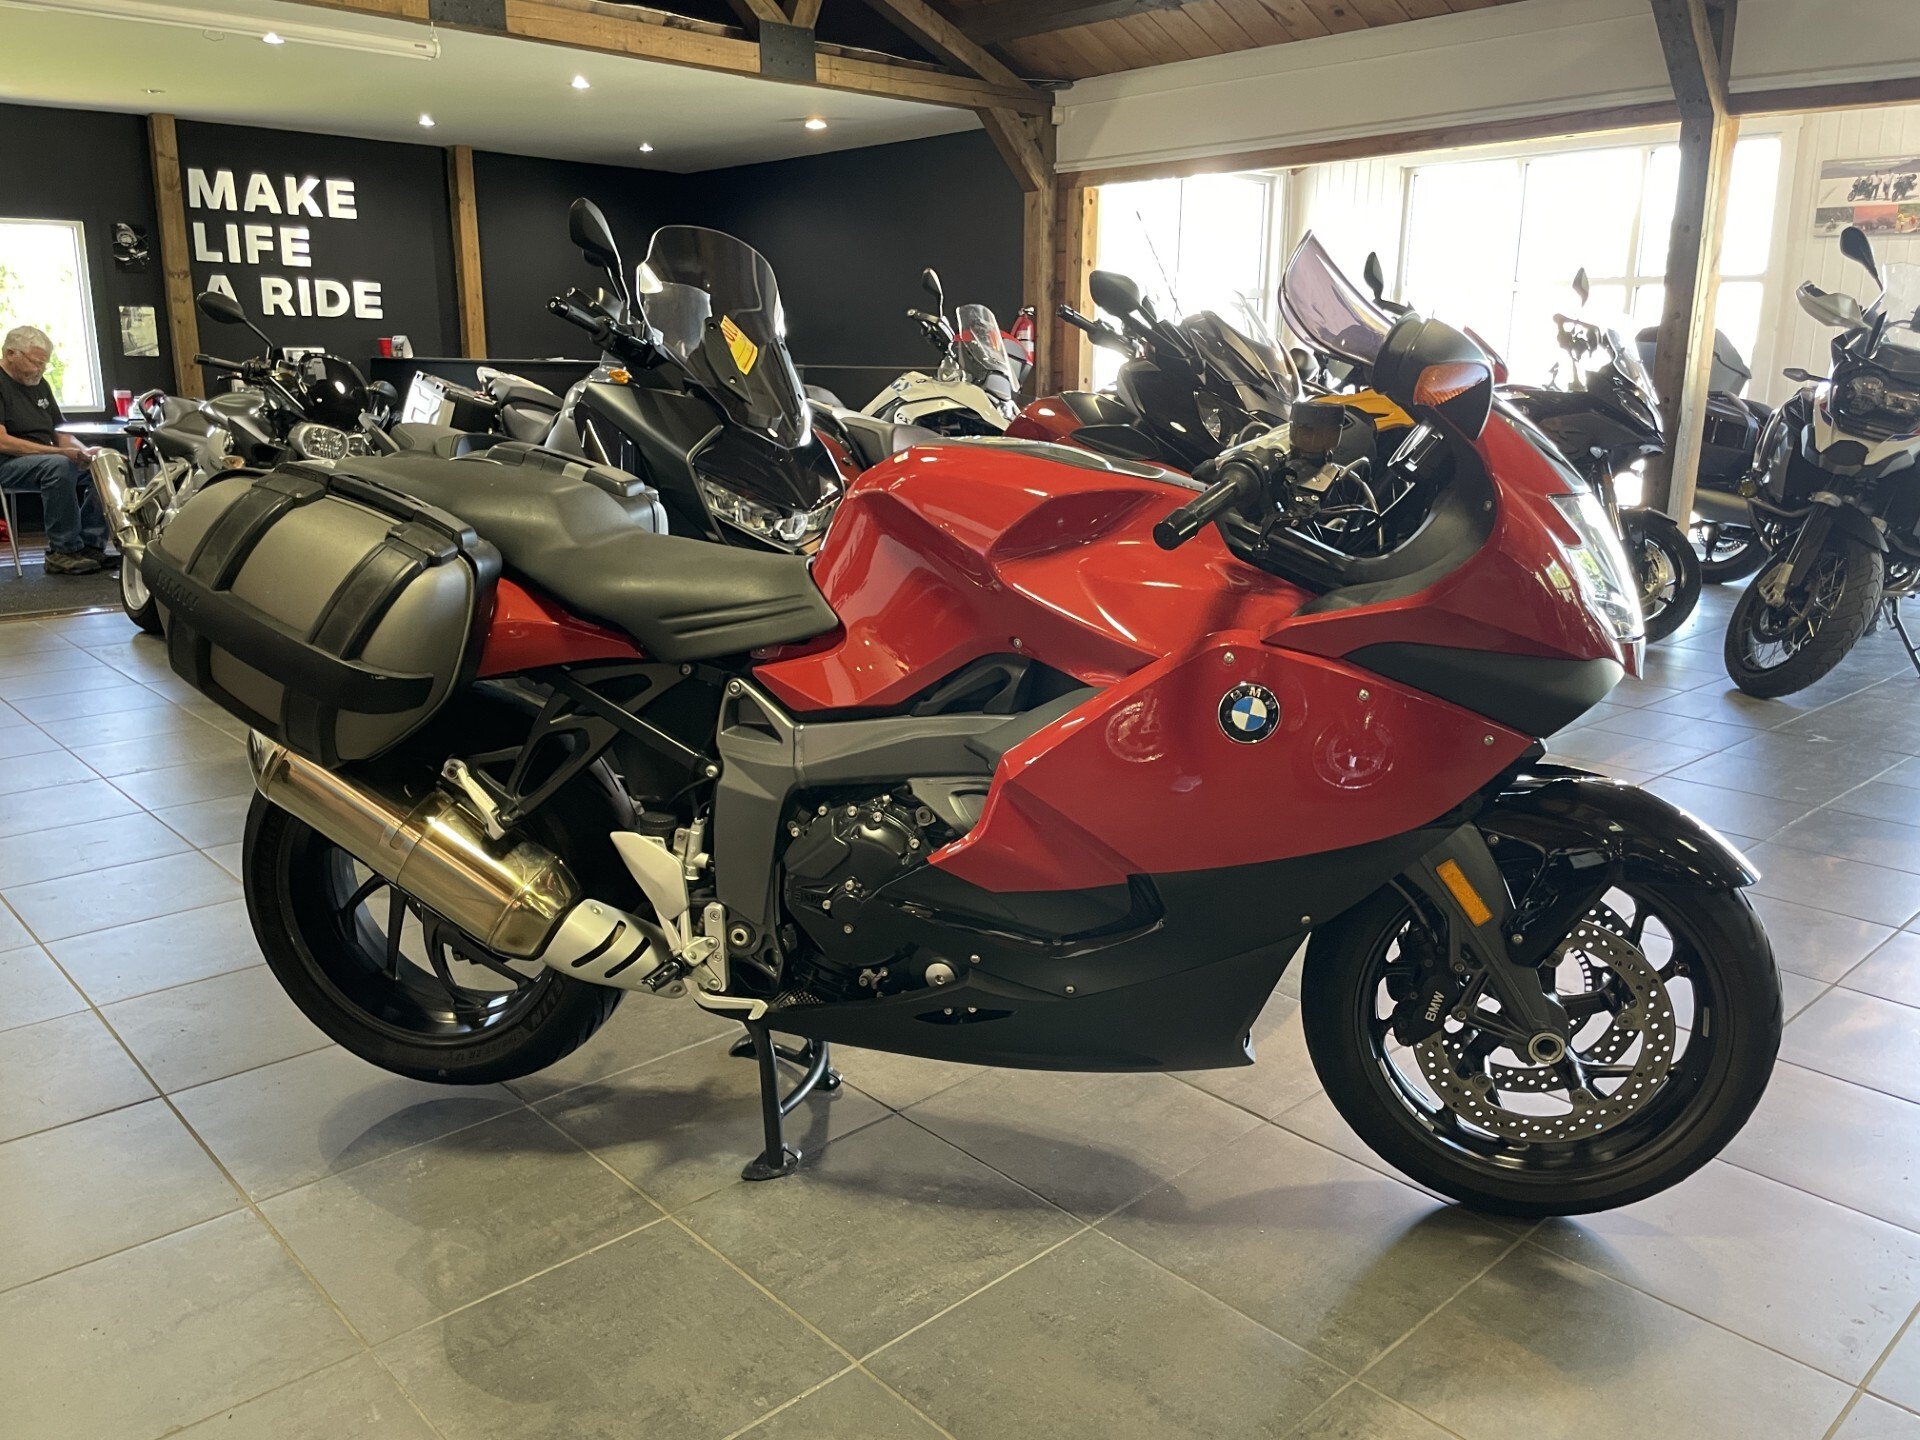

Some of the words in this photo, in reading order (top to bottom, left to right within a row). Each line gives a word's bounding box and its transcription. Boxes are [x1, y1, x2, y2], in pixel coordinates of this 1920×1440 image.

[188, 168, 357, 219] MAKE
[193, 222, 311, 267] LIFE
[260, 276, 383, 319] RIDE
[1425, 991, 1445, 1022] BMW
